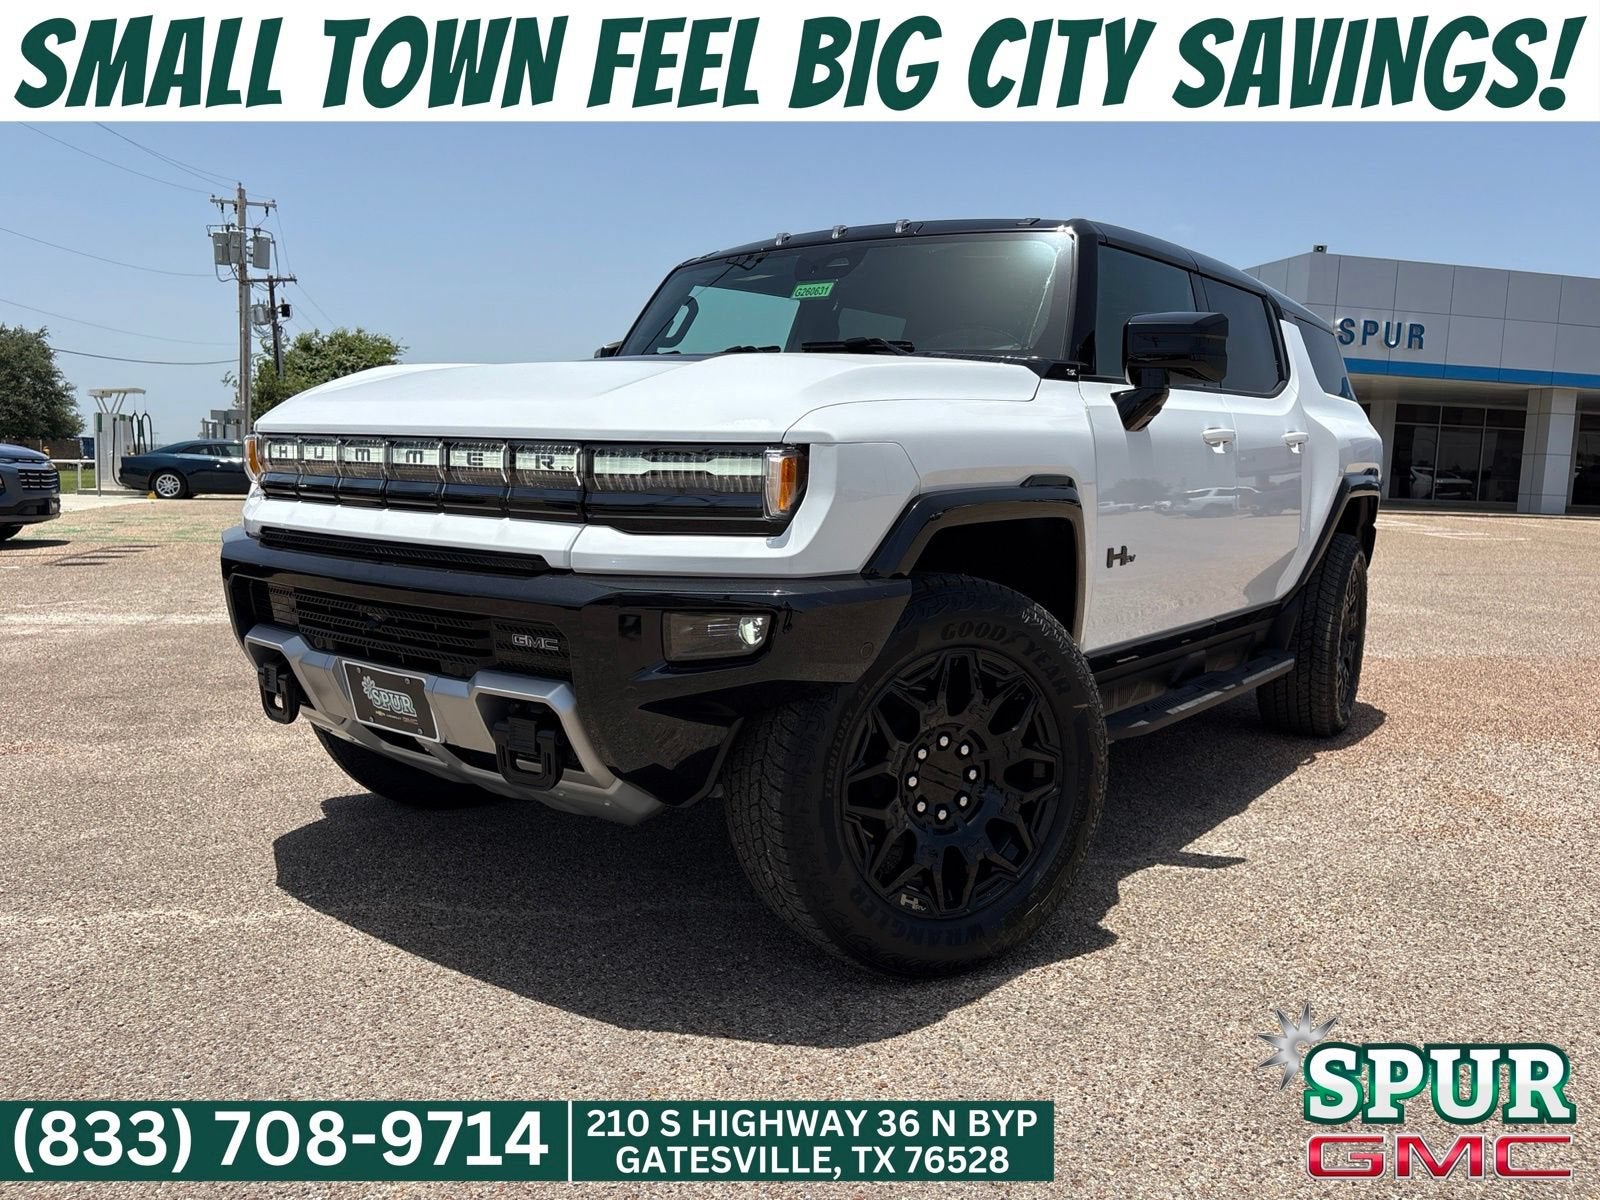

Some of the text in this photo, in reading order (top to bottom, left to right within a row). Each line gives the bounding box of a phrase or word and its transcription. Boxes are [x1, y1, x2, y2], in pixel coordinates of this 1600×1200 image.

[1338, 318, 1425, 350] SPUR
[511, 633, 559, 651] GMC
[371, 687, 417, 717] SPUR
